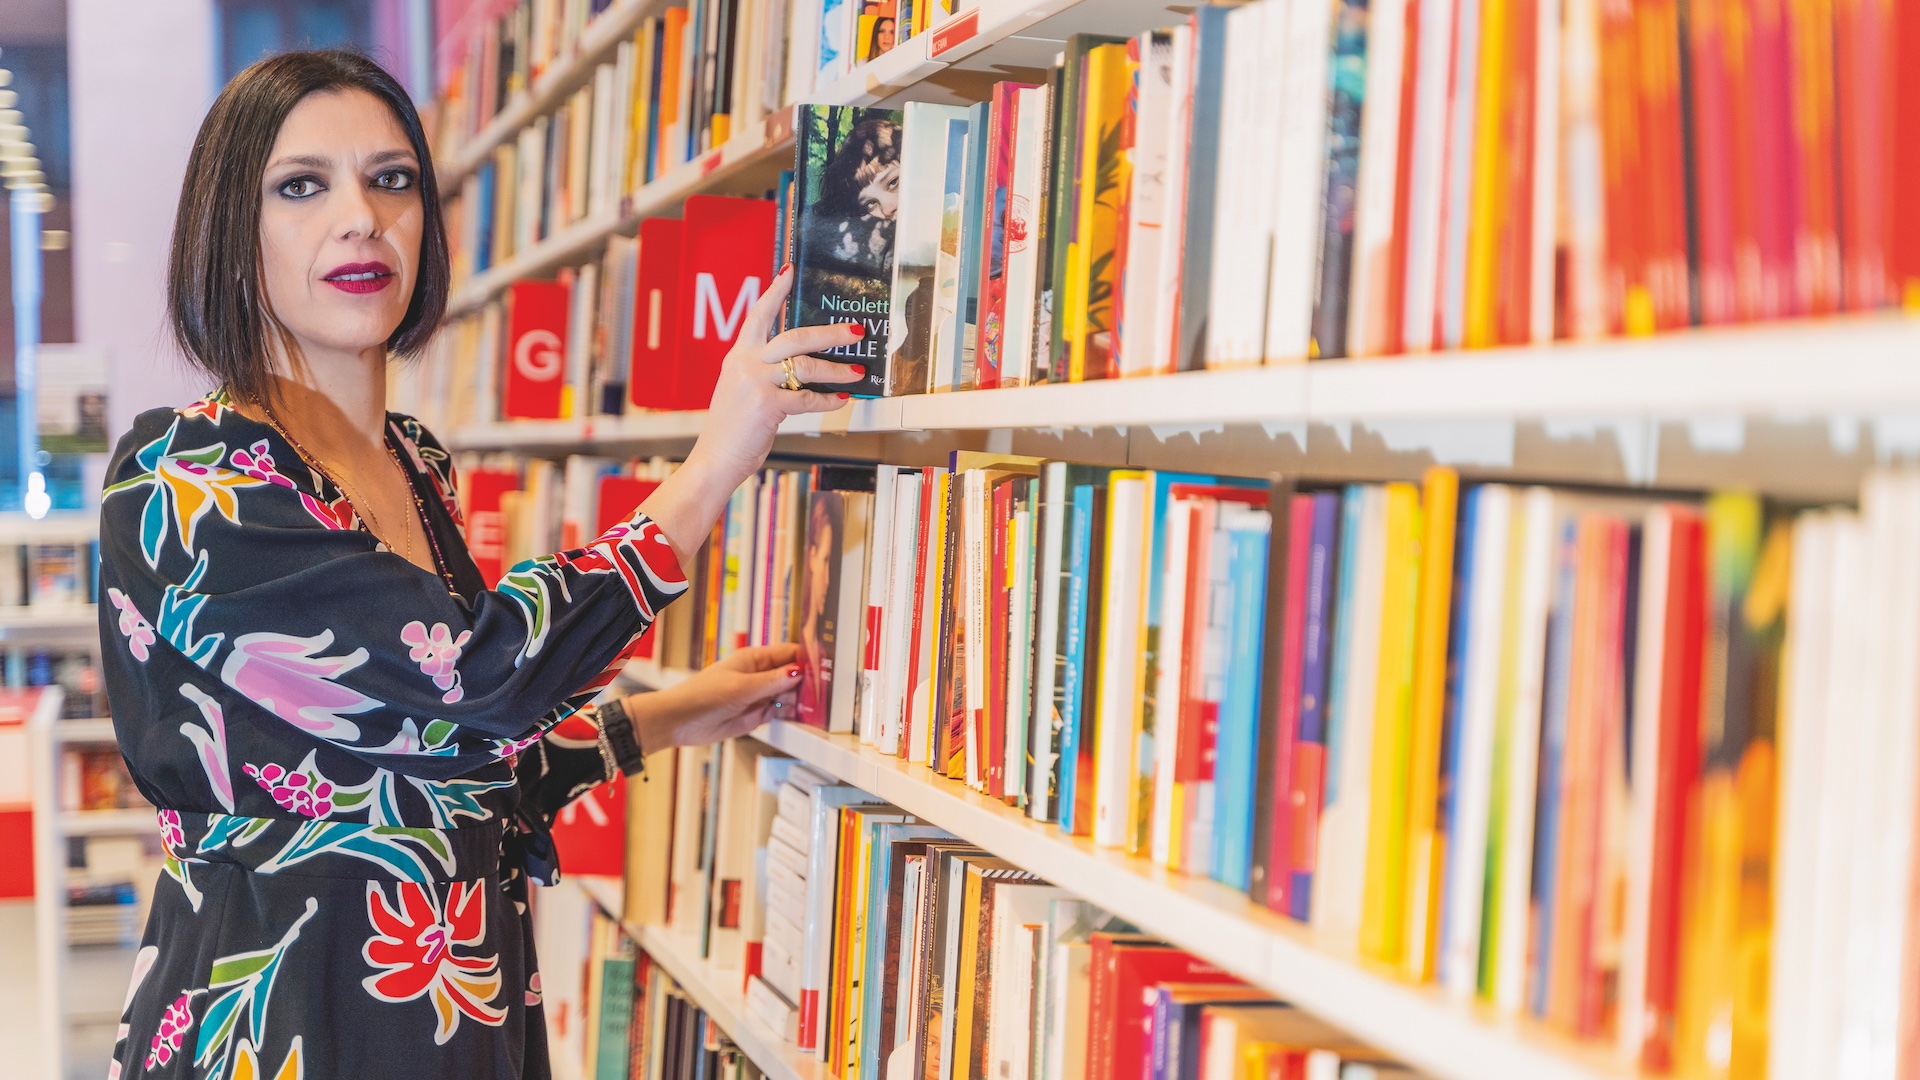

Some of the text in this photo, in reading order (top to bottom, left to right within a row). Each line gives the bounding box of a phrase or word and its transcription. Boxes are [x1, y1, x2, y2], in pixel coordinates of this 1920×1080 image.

[693, 272, 761, 341] M
[821, 294, 890, 314] Nicolett
[515, 329, 561, 381] G
